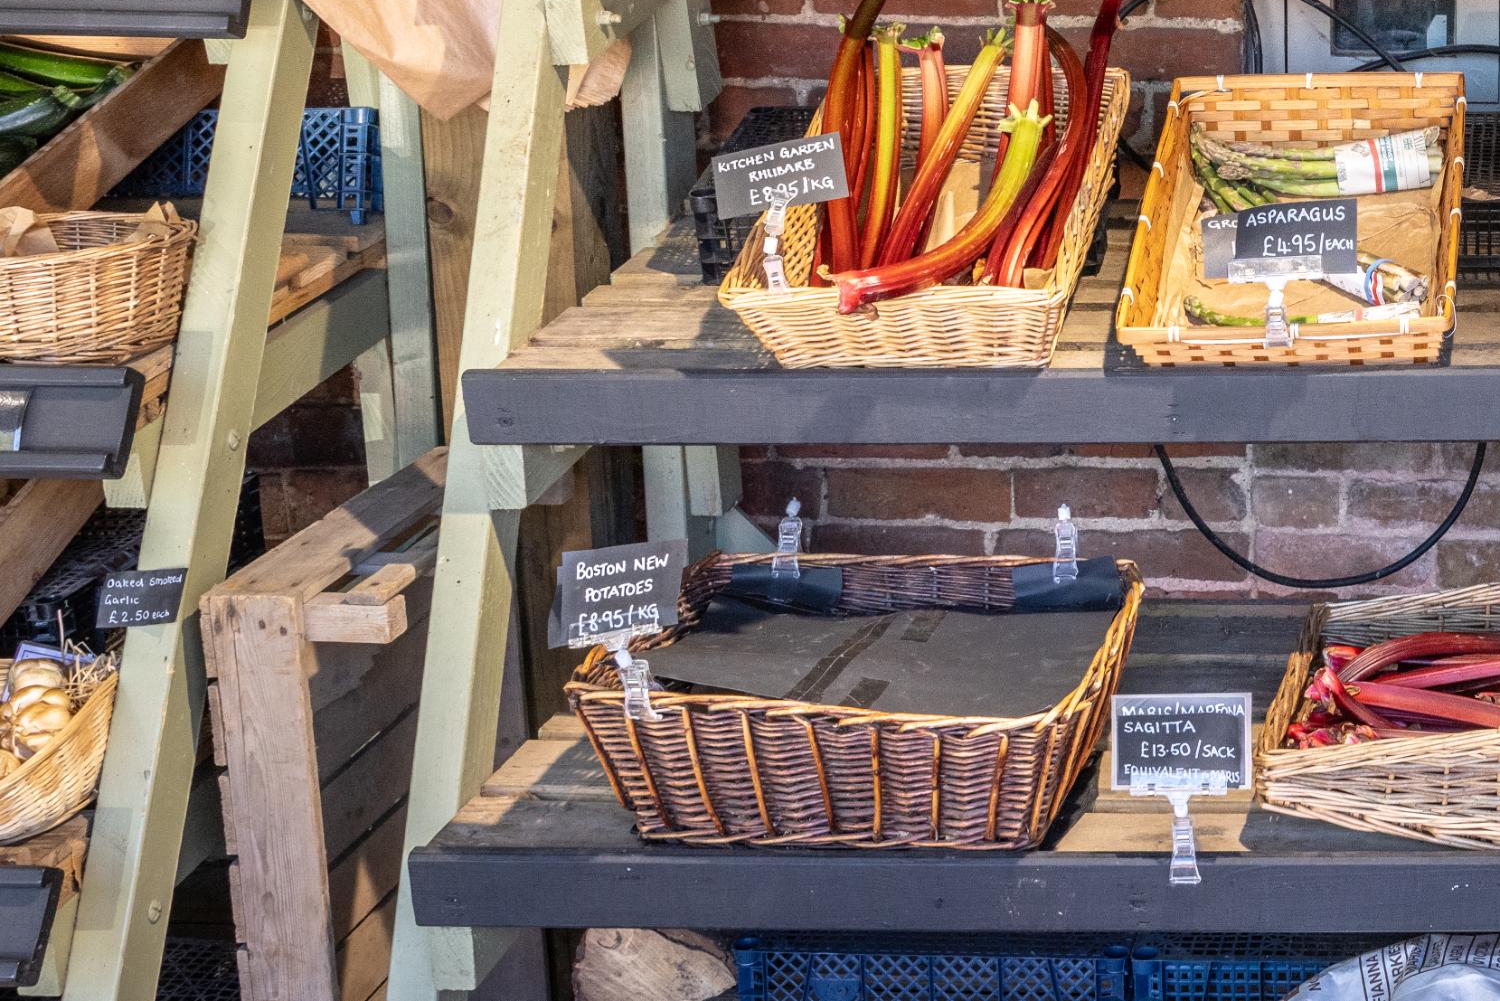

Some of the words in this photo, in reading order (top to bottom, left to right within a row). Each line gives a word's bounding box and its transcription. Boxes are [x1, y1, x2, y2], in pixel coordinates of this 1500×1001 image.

[718, 151, 775, 173] KITCHEN
[780, 138, 835, 158] GARDEN
[749, 158, 815, 182] RHUBARB
[1246, 206, 1346, 227] ASPARAGUS
[576, 560, 626, 580] BOSTON
[633, 553, 669, 571] NEW
[107, 578, 144, 588] Oaked
[585, 579, 653, 602] POTATOES
[104, 594, 140, 605] Garlic
[152, 609, 170, 619] each
[1124, 720, 1196, 734] SAGITTA
